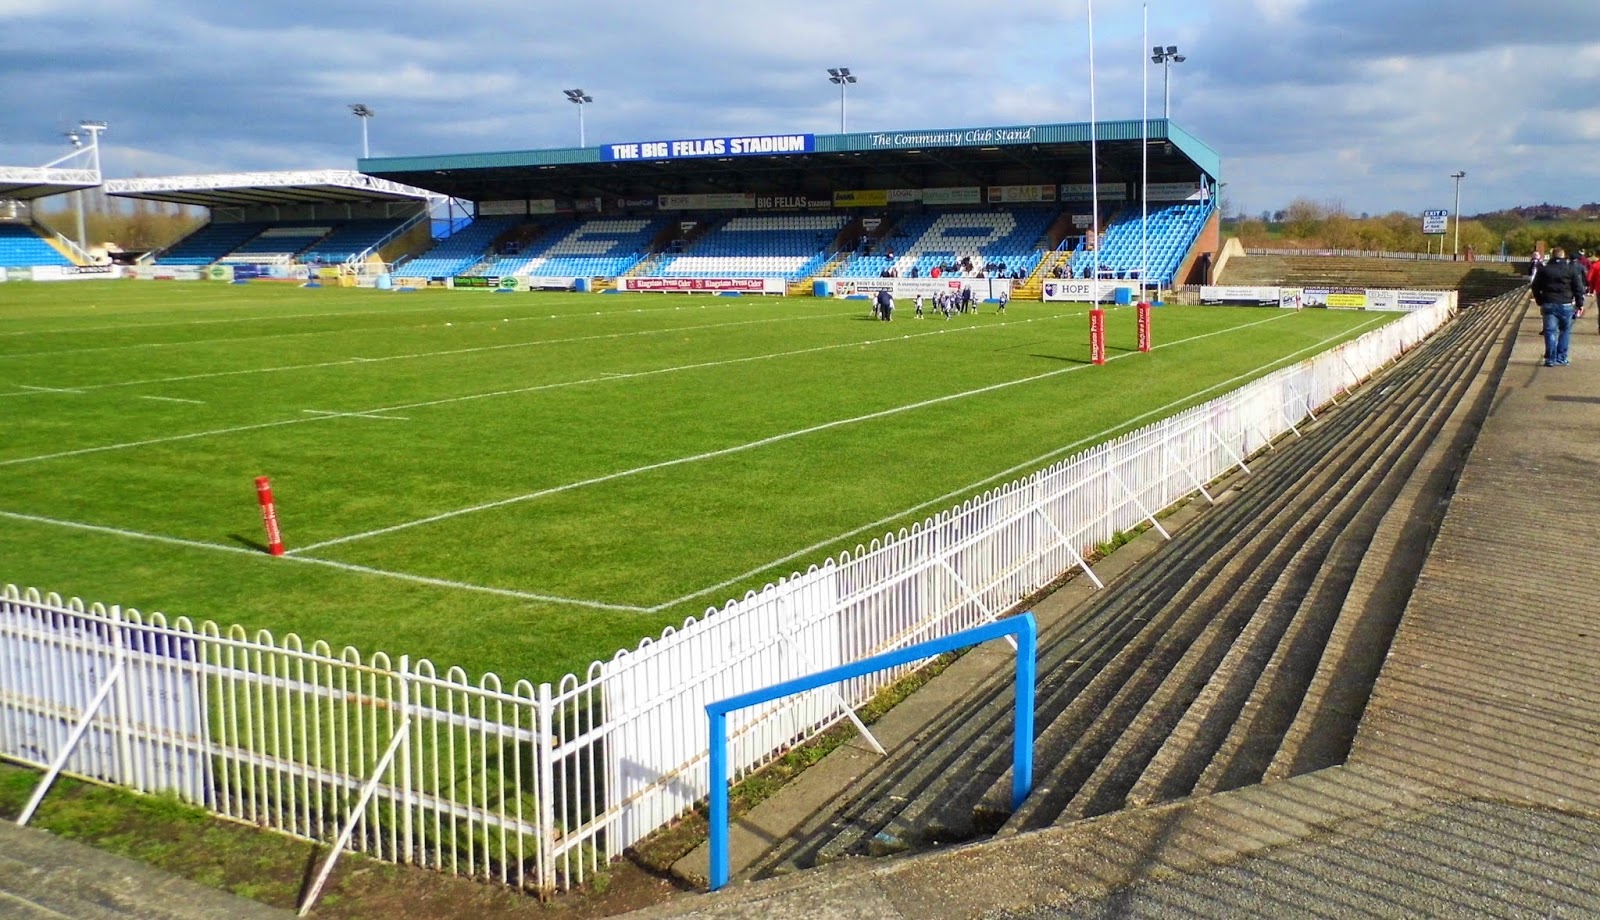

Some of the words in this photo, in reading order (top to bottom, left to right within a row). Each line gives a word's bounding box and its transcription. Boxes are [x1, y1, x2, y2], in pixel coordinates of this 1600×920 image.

[894, 132, 962, 146] Community
[966, 129, 992, 142] Club
[611, 144, 638, 160] THE
[642, 142, 668, 158] BIG
[672, 139, 726, 156] FELLAS
[730, 136, 804, 153] STADIUM
[758, 197, 772, 208] BIG
[774, 196, 806, 208] FELLAS
[1062, 285, 1089, 293] HOPE
